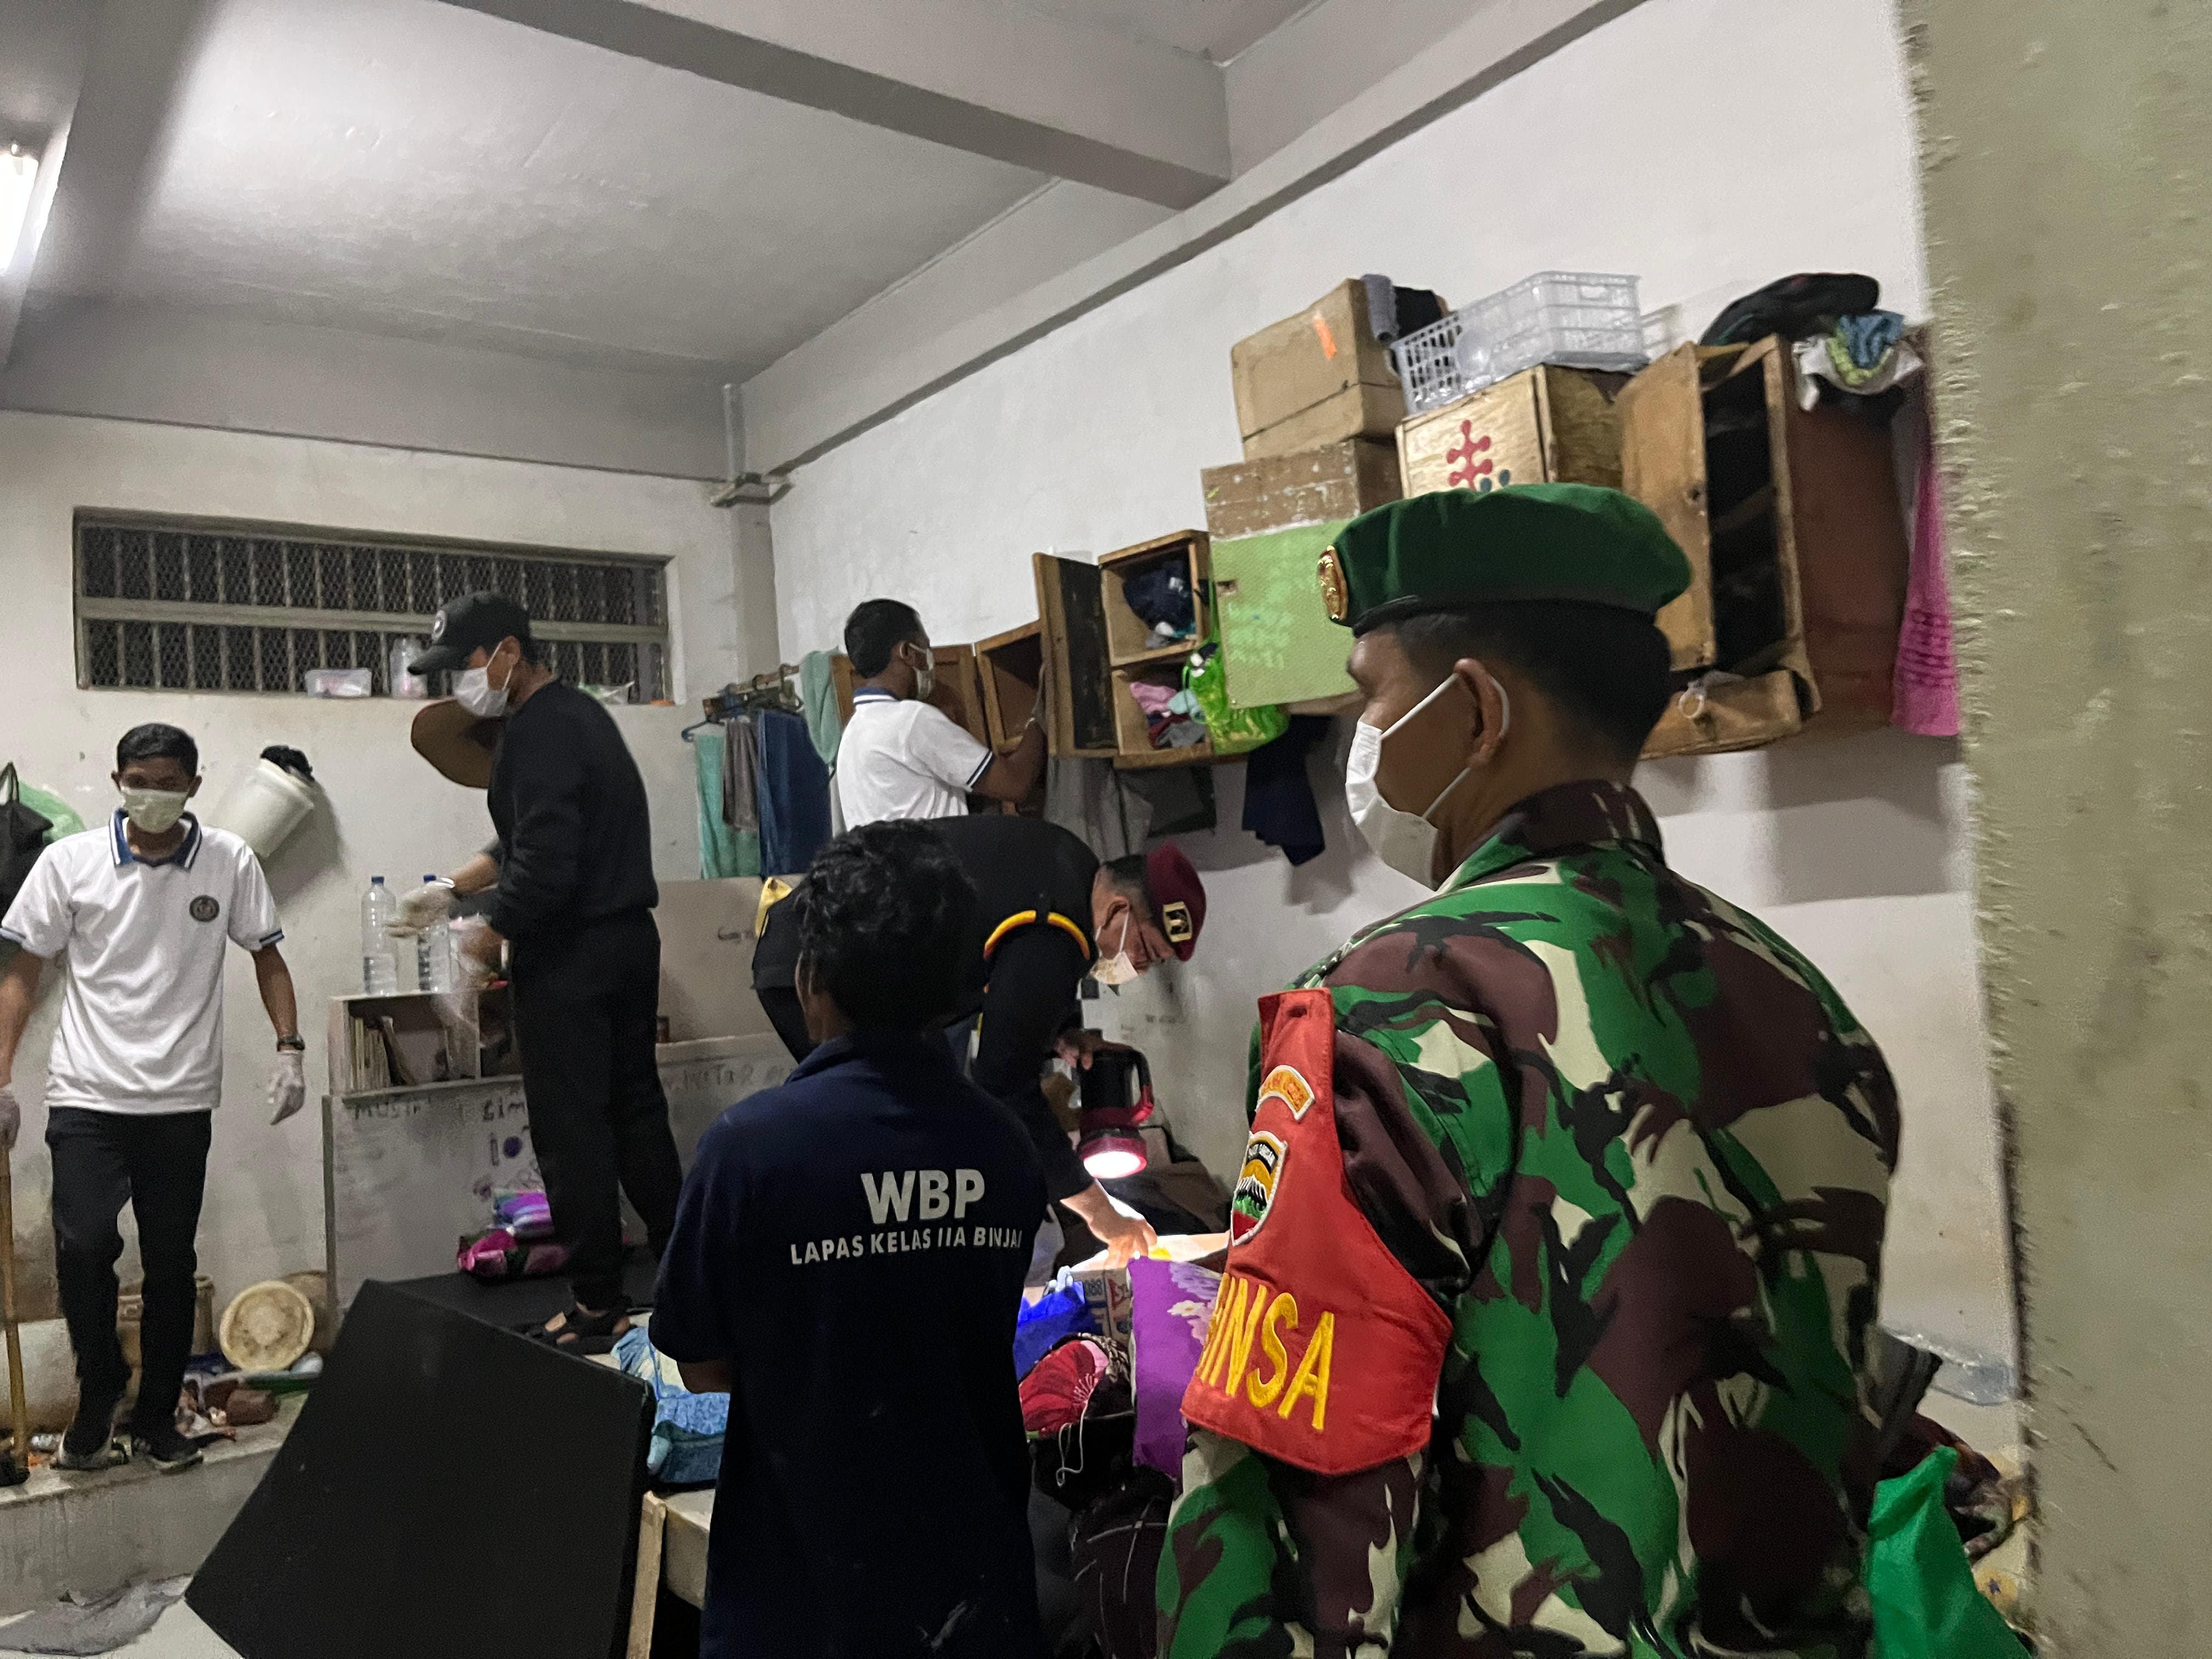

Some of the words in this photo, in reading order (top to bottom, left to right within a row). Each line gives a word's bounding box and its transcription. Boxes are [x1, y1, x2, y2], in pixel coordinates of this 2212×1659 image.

[860, 1169, 985, 1224] WBP
[790, 1235, 864, 1265] LAPAS
[870, 1228, 931, 1254] KELAS
[938, 1226, 966, 1248] IIA
[973, 1226, 1023, 1248] BINJAI
[1196, 1273, 1335, 1431] INSA
